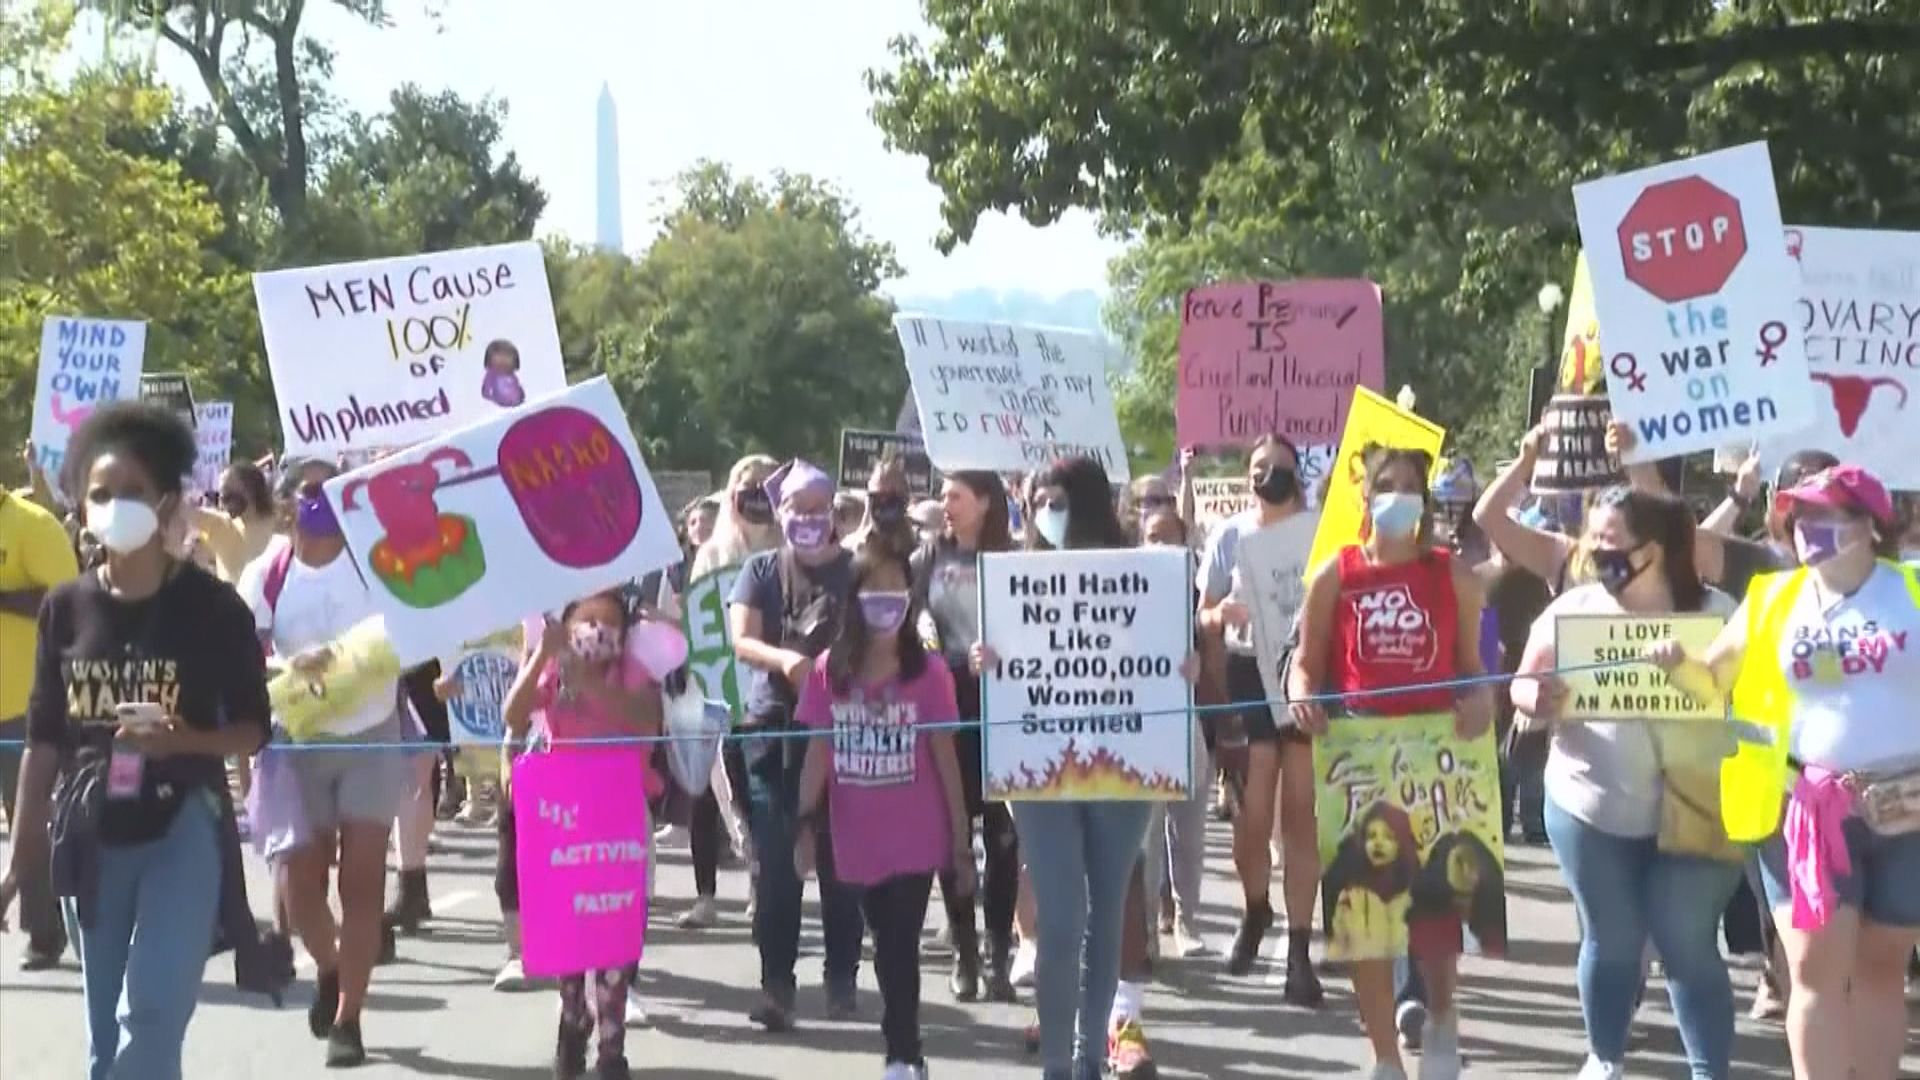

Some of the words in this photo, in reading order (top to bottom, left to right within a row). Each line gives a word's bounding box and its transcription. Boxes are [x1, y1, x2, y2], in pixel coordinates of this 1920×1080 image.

[1631, 215, 1730, 262] STOP
[305, 273, 394, 319] MEN
[407, 261, 516, 305] Cause
[387, 302, 472, 361] 100%
[1666, 301, 1729, 339] the
[58, 319, 126, 349] MIND
[1246, 320, 1290, 353] IS
[57, 346, 122, 373] YOUR
[1184, 350, 1241, 389] Cruel
[1659, 338, 1731, 376] war
[51, 373, 122, 402] OWN
[1685, 374, 1730, 402] on
[289, 387, 452, 445] Unplanned
[1639, 396, 1778, 444] women
[1009, 574, 1067, 597] Hell
[1079, 572, 1149, 595] Hath
[1359, 589, 1408, 609] NO
[1022, 602, 1061, 625] No
[1073, 602, 1137, 628] Fury
[1365, 609, 1424, 630] MO
[1049, 629, 1112, 652] Like
[1625, 624, 1672, 641] LOVE
[72, 659, 177, 682] WON'S
[995, 655, 1172, 683] 162,000,000
[1593, 671, 1640, 688] WHO
[1650, 671, 1674, 688] HA
[1792, 655, 1888, 681] BDY
[1027, 685, 1135, 707] Women
[1575, 694, 1600, 711] AN
[830, 703, 918, 724] WON'S
[1021, 712, 1143, 735] Scorned
